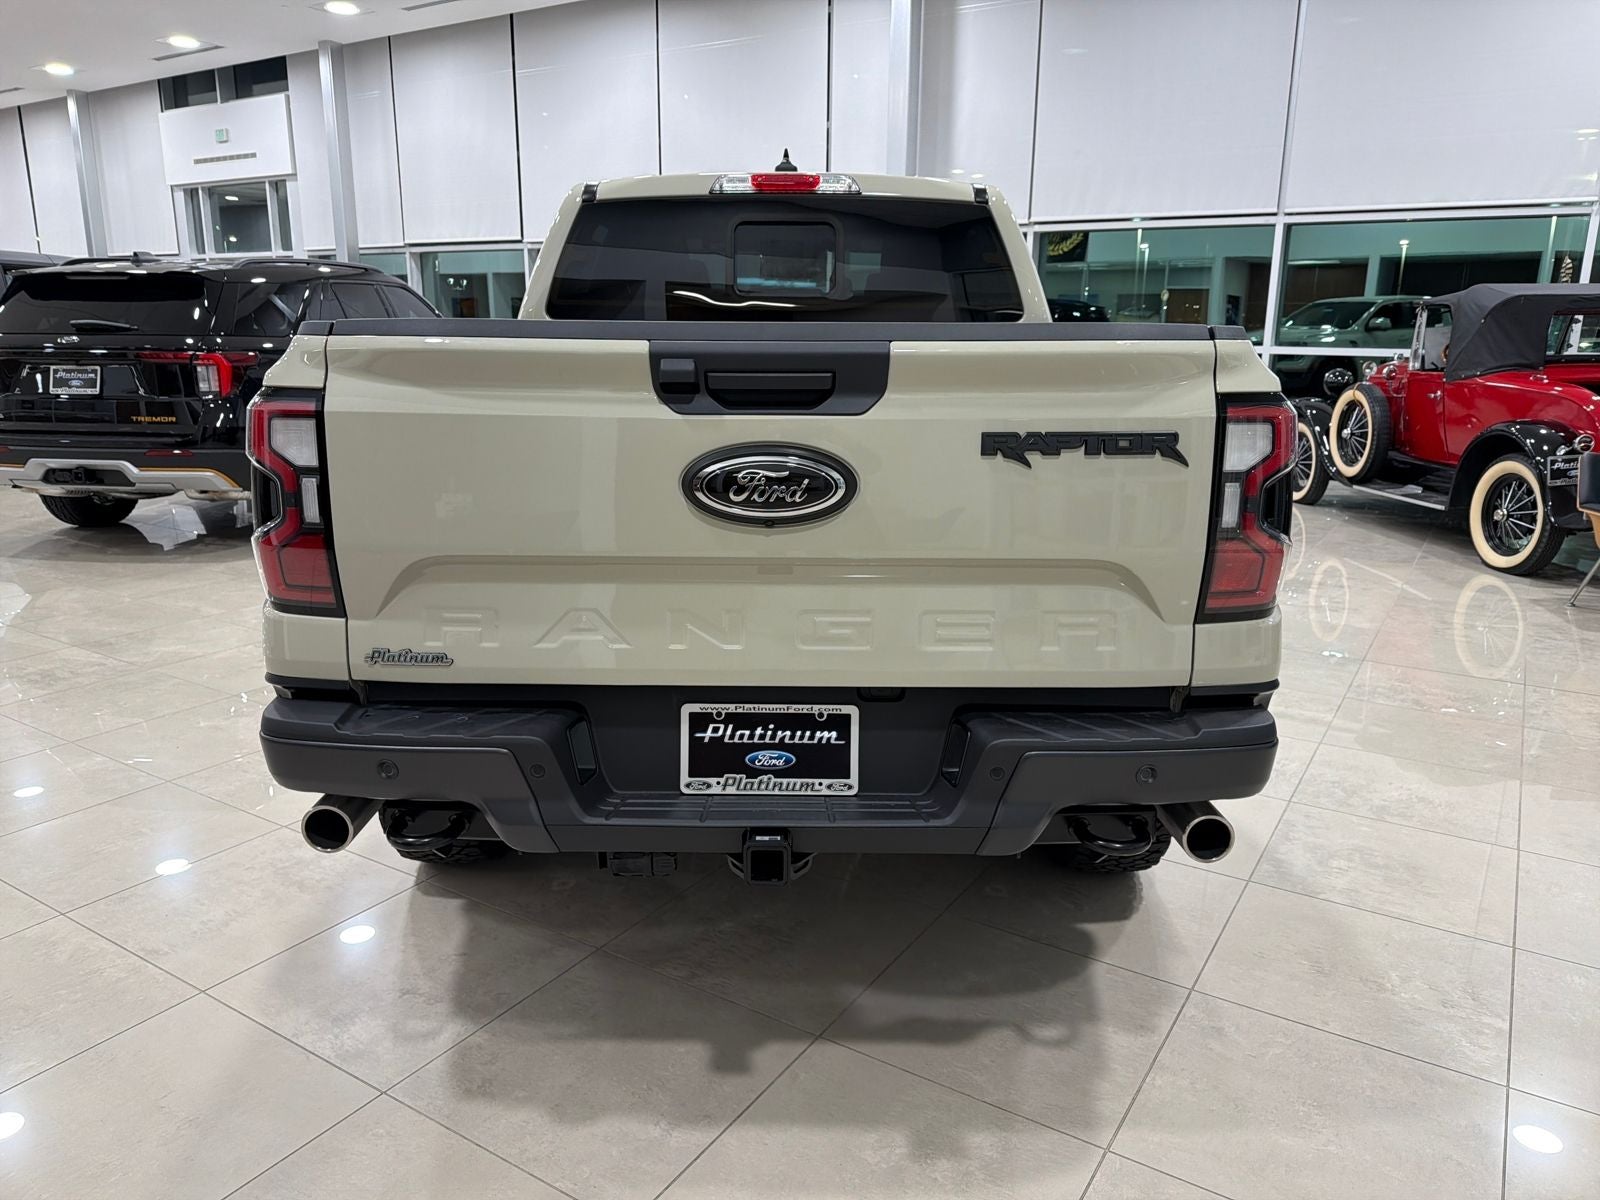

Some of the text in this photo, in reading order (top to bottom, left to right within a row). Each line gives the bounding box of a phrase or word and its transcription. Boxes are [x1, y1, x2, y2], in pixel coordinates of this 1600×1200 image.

[981, 431, 1189, 469] RAPTOR
[1551, 461, 1579, 470] Plati
[728, 469, 810, 503] Ford
[423, 606, 1118, 653] RANGER
[364, 648, 454, 666] Platinum
[699, 705, 842, 713] www.PlatinumFord.com
[694, 723, 846, 745] Platinum
[754, 752, 787, 767] Ford
[721, 775, 823, 793] Platinum
